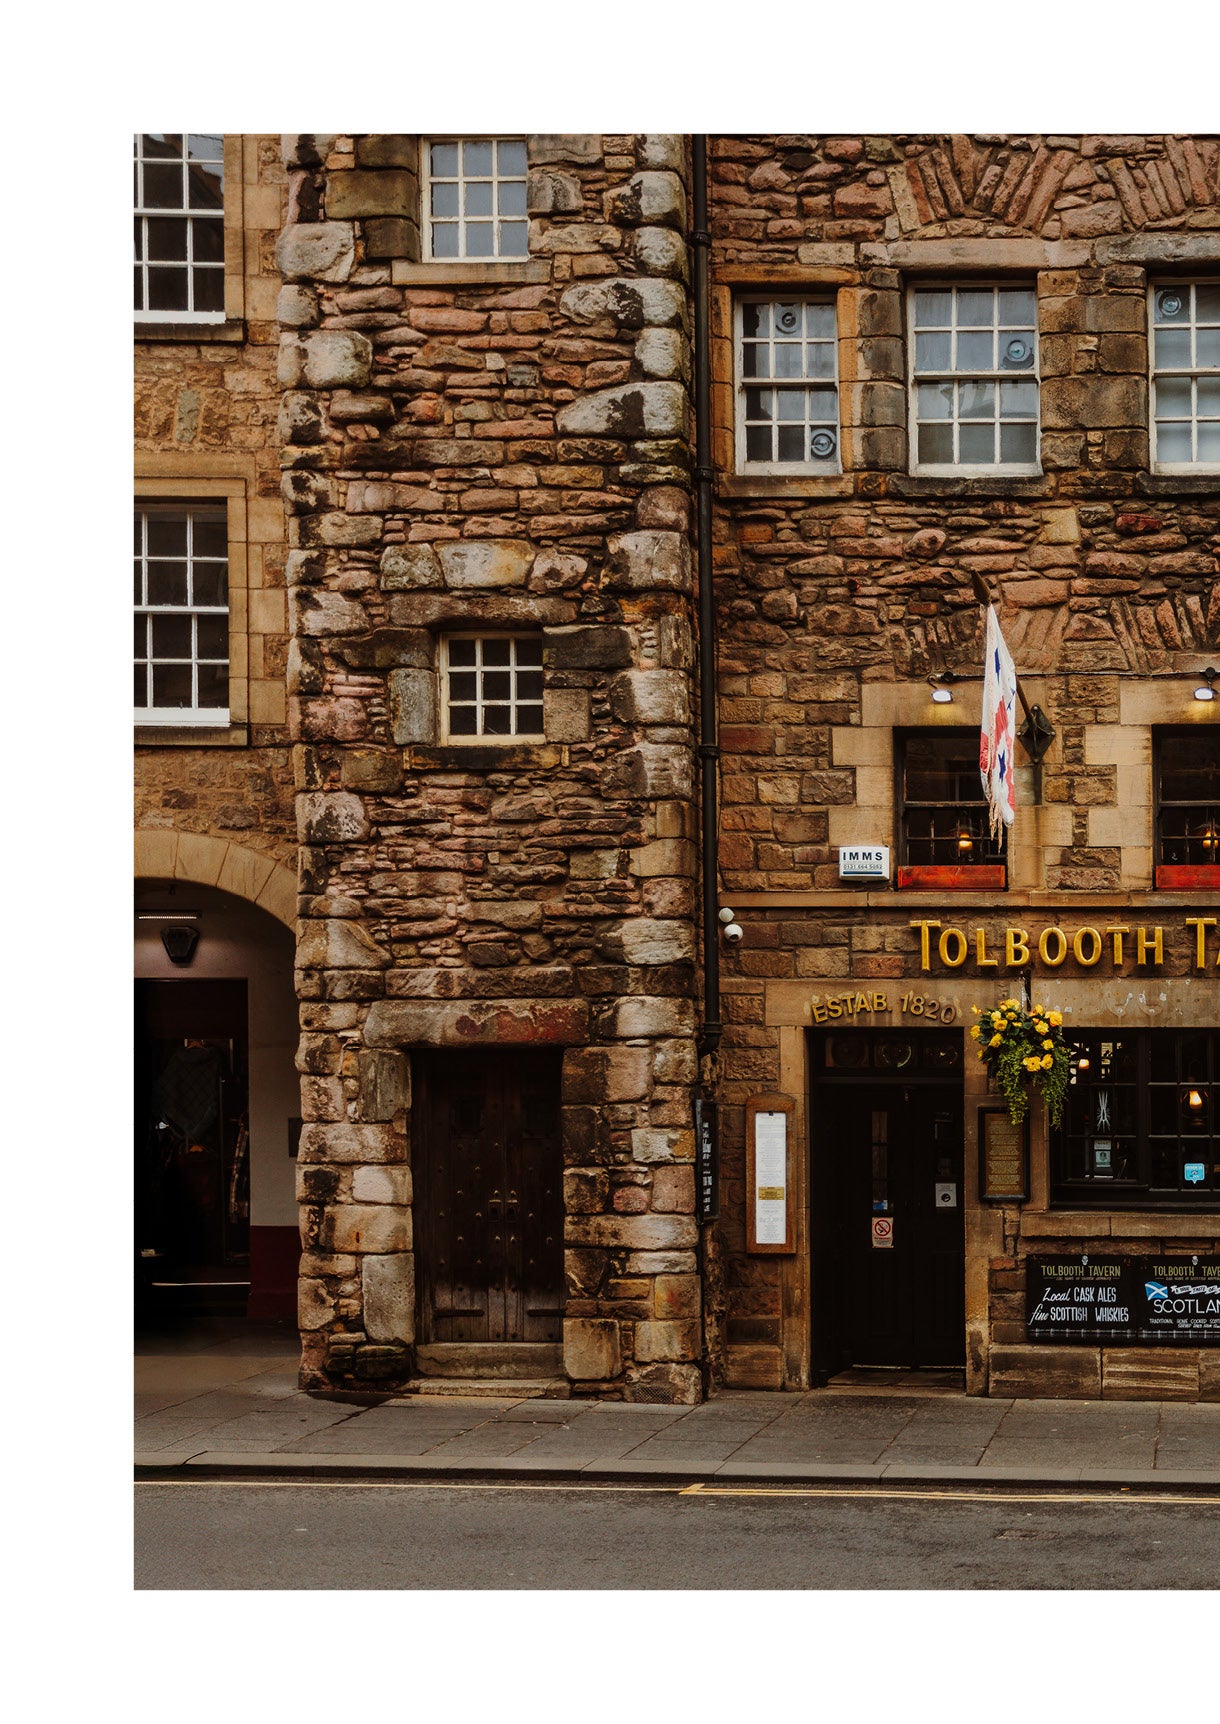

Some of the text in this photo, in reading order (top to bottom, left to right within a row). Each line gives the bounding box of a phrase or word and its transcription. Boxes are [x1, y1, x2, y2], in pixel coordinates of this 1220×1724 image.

[843, 852, 882, 861] IMMS
[909, 919, 1164, 971] TOLBOOTH
[811, 992, 956, 1024] ESTAB. 1820
[1041, 1265, 1121, 1277] TOLBOOTH TAVERN
[1153, 1265, 1195, 1277] TOLBOOTH
[1042, 1287, 1117, 1302] Local CASK ALES
[1027, 1303, 1130, 1326] fine SCOTTISH WHISKIES
